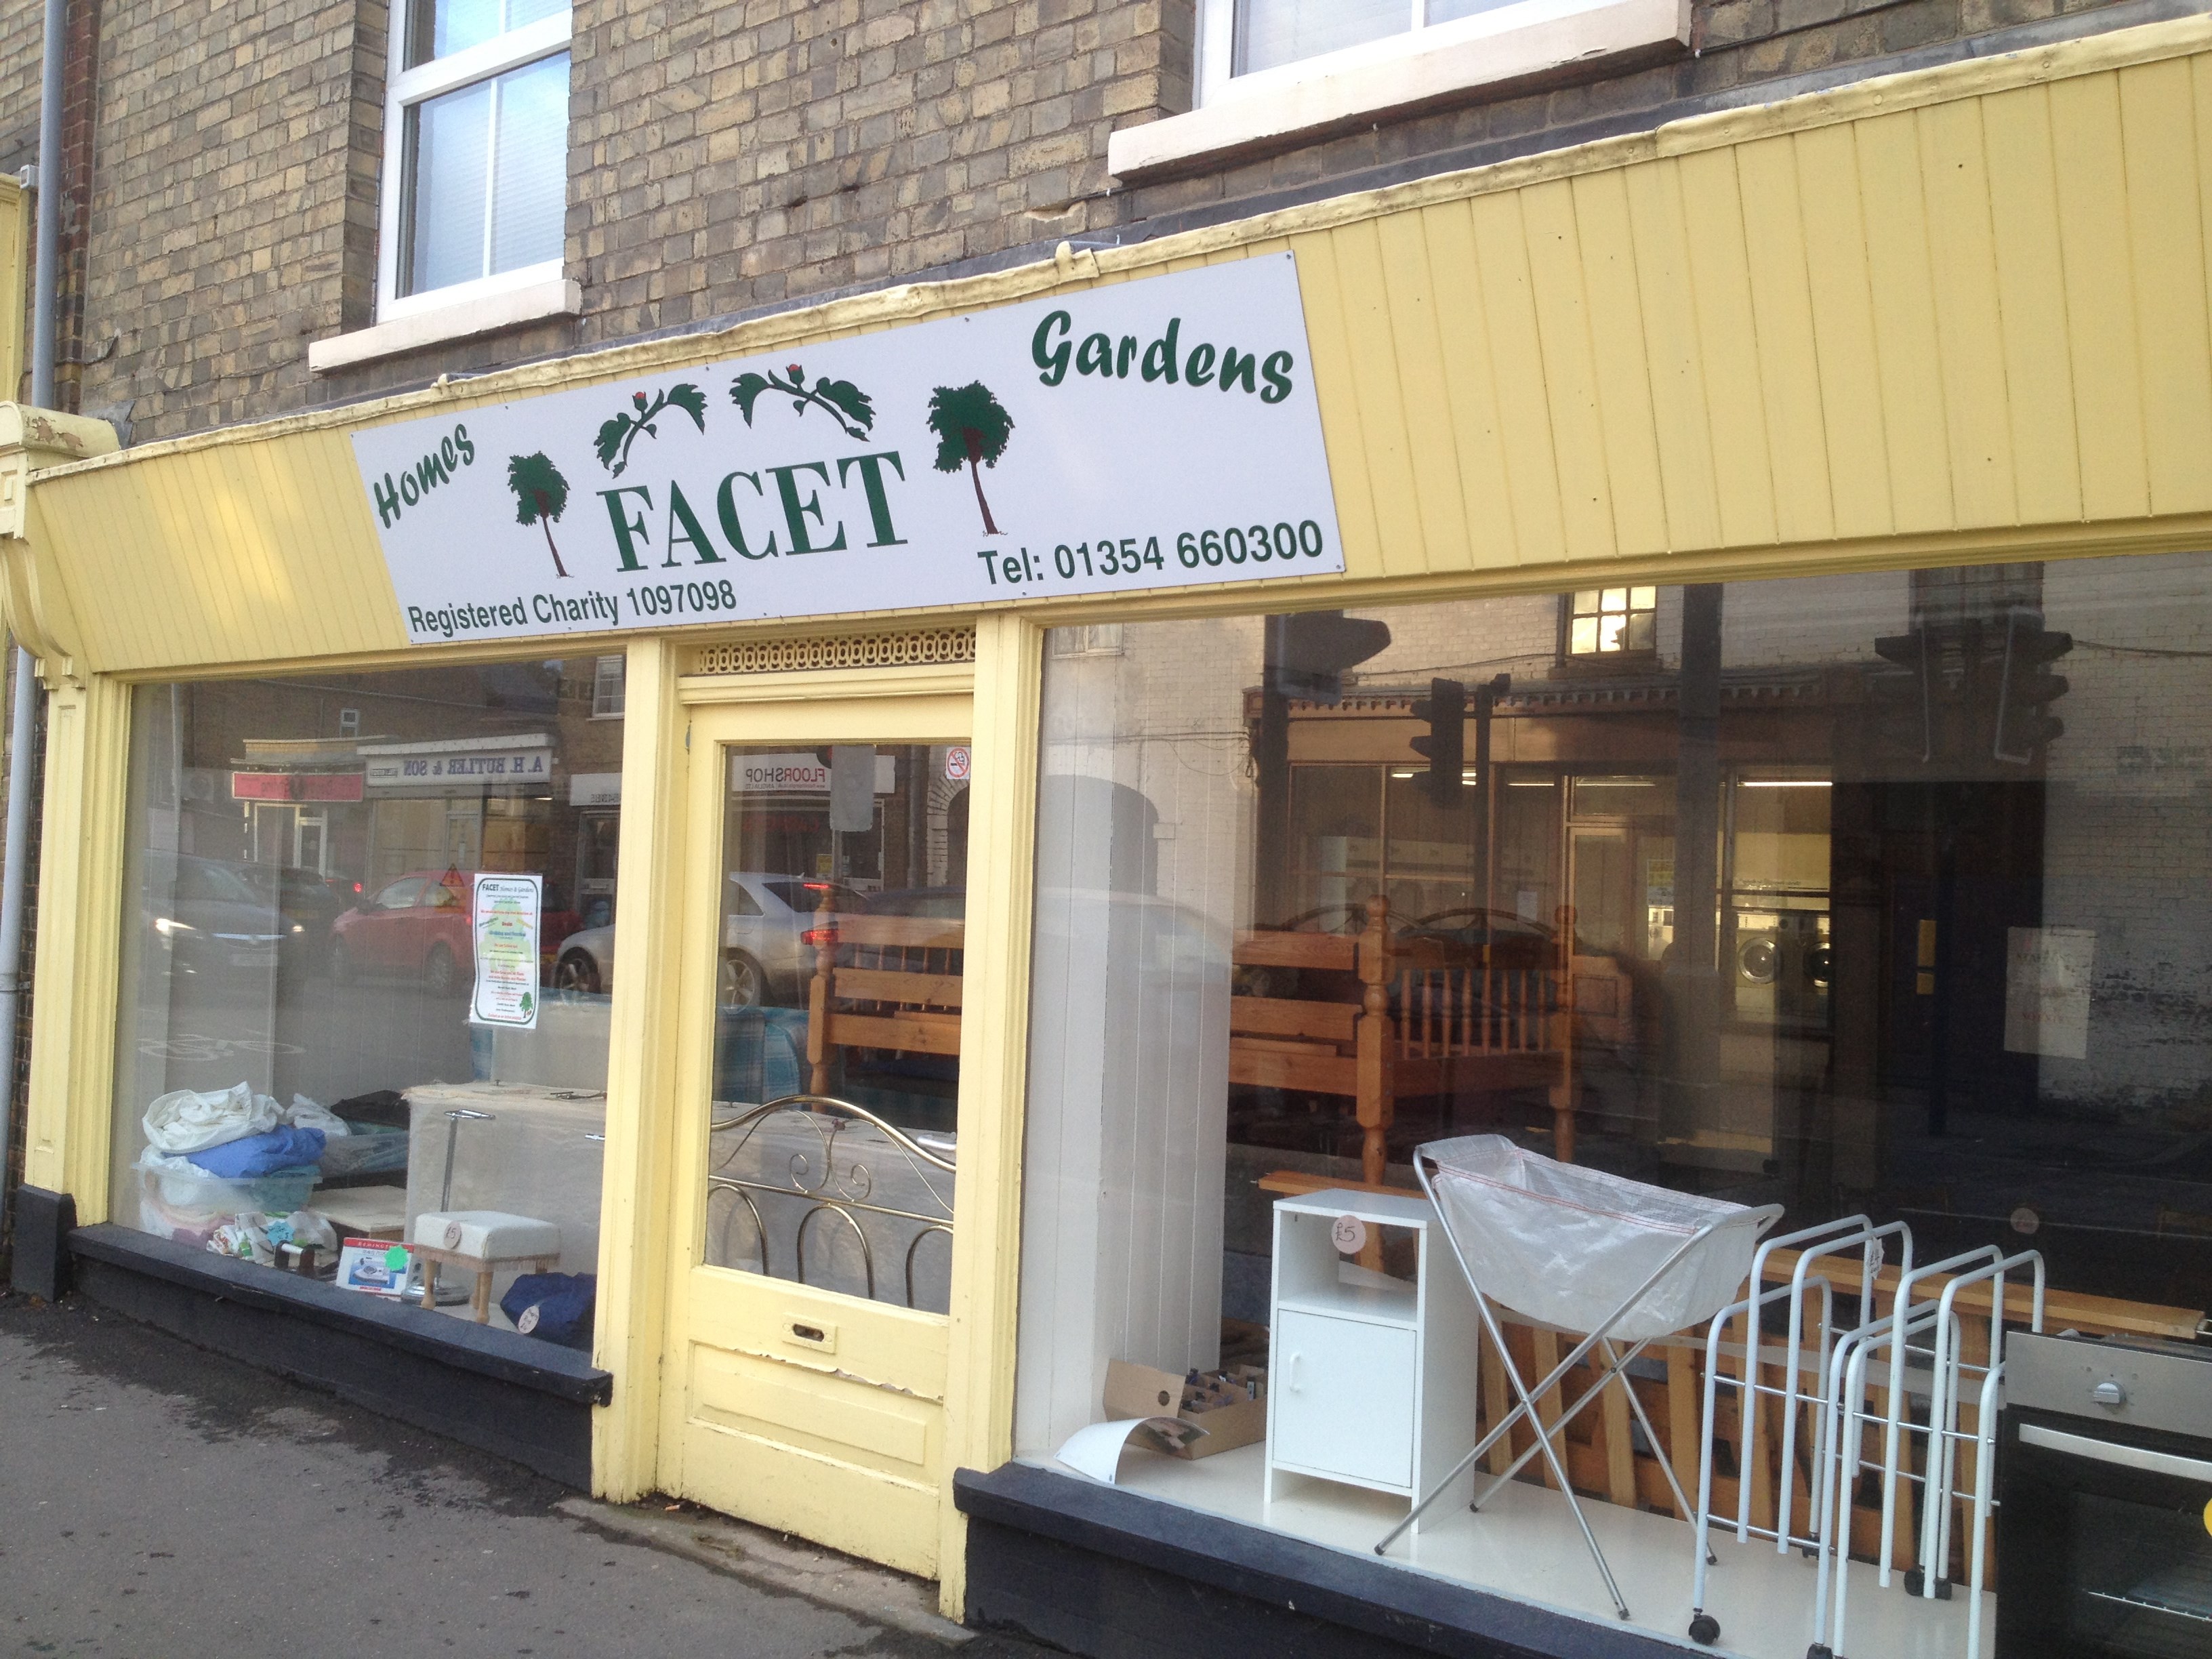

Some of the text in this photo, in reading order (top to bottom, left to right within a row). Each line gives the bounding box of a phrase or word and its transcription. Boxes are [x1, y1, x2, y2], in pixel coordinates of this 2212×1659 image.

[1031, 310, 1294, 405] Gardens
[373, 423, 475, 529] Homes
[596, 450, 908, 573] FACET
[977, 520, 1324, 586] Tel: 01354 660300
[408, 579, 737, 638] Registered Charity 1097098
[358, 1241, 390, 1249] REMINGT
[445, 1226, 457, 1240] £5
[1336, 1222, 1356, 1242] £5
